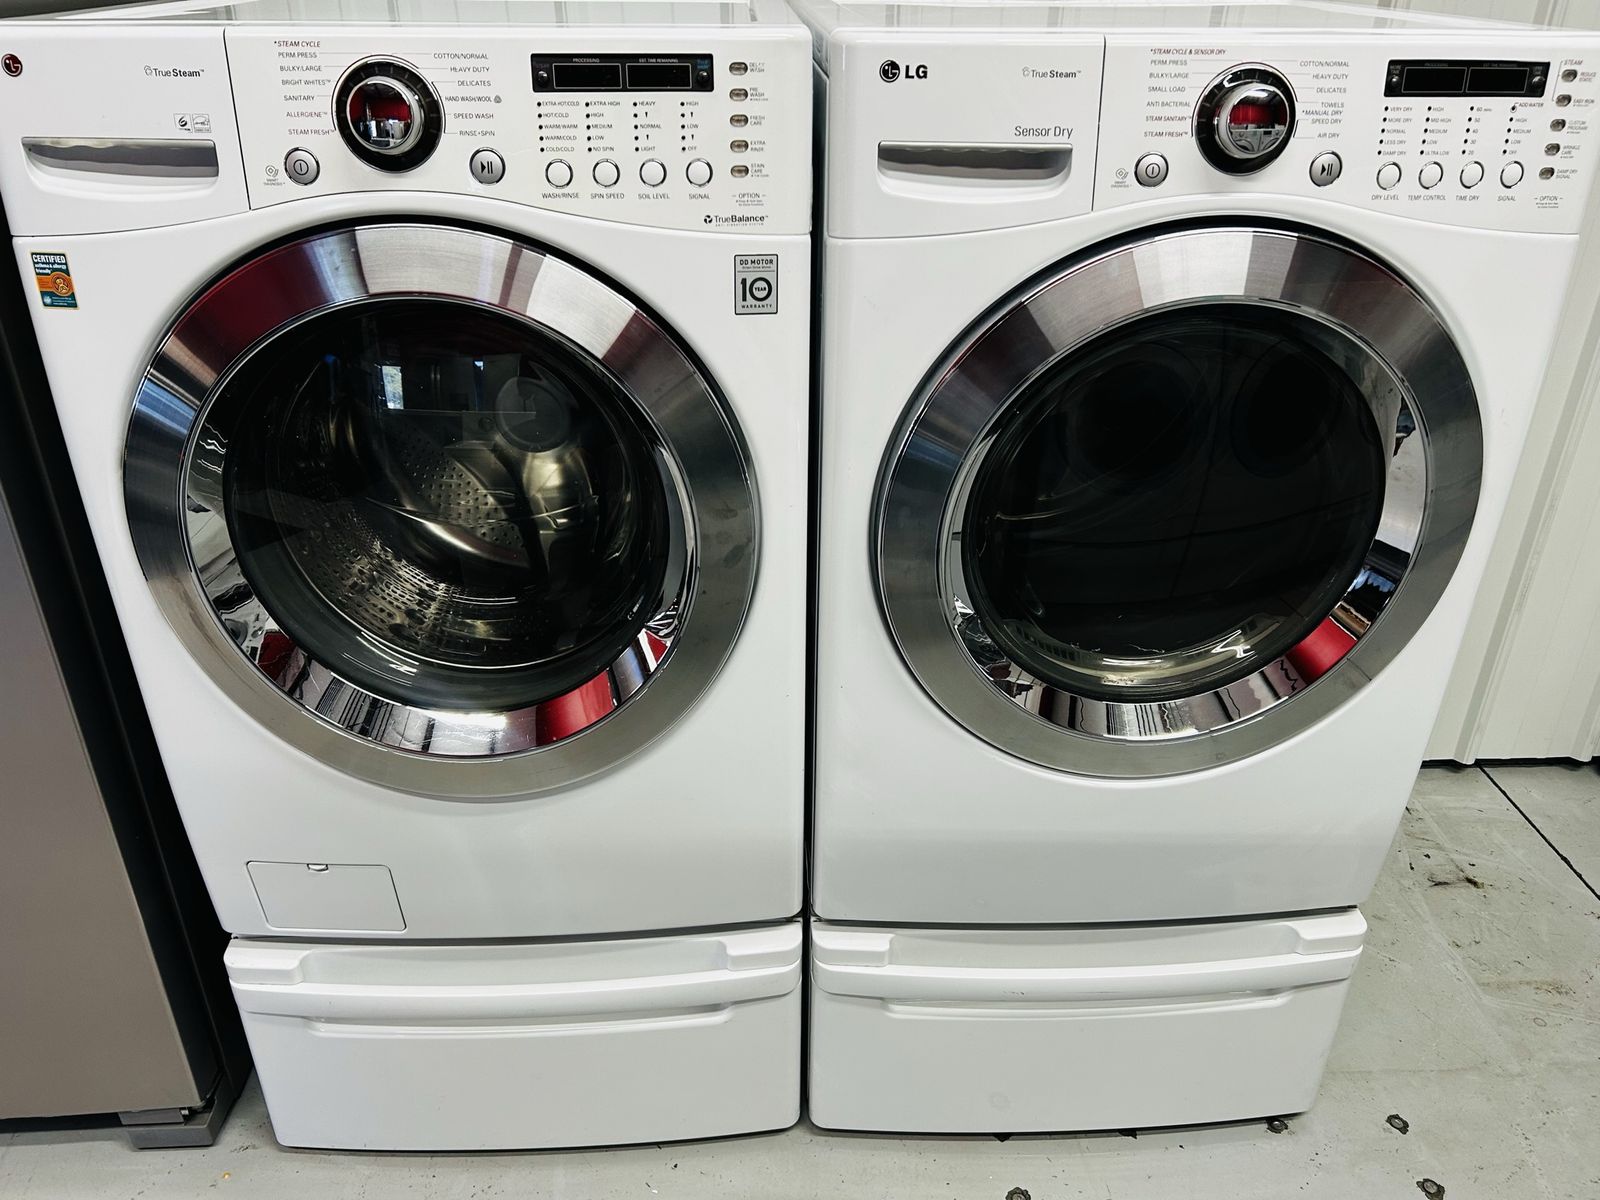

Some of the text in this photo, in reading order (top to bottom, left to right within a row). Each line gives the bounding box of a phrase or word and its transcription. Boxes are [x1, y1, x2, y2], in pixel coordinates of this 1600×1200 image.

[905, 64, 928, 79] LG
[1014, 126, 1073, 139] Sensor Dry
[32, 255, 66, 263] CERTIFIED
[741, 276, 772, 302] 10
